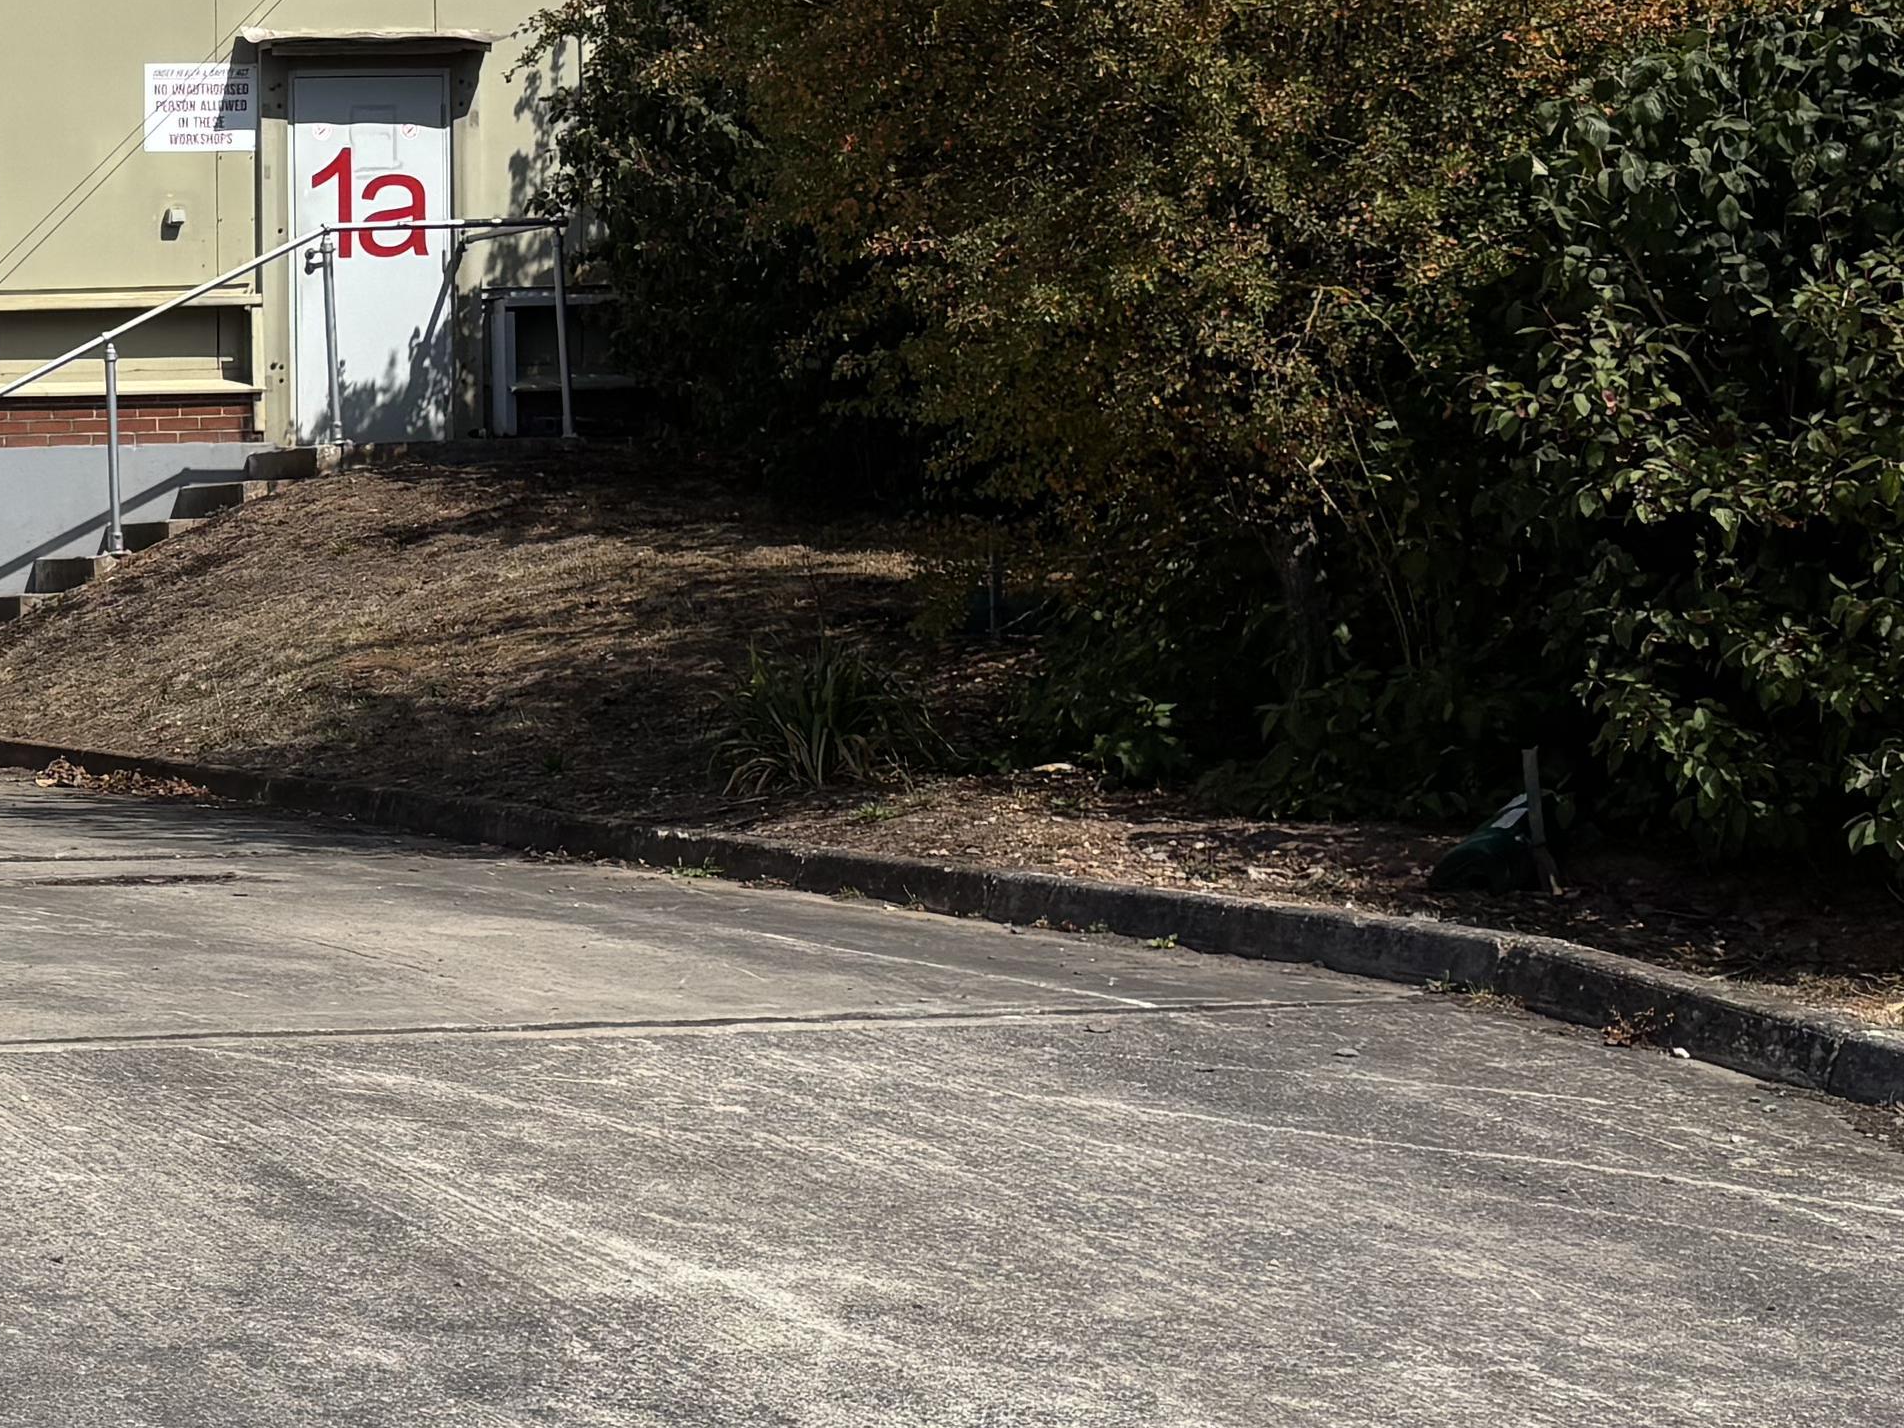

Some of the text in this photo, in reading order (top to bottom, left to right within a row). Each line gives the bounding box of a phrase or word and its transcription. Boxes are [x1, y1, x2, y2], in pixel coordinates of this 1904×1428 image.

[154, 83, 249, 95] NO UNAUTHORISED
[155, 99, 248, 113] PERSON ALLOWED
[178, 116, 226, 128] IN THESE
[169, 133, 233, 145] WORKSHOPS
[311, 147, 430, 259] 1a
